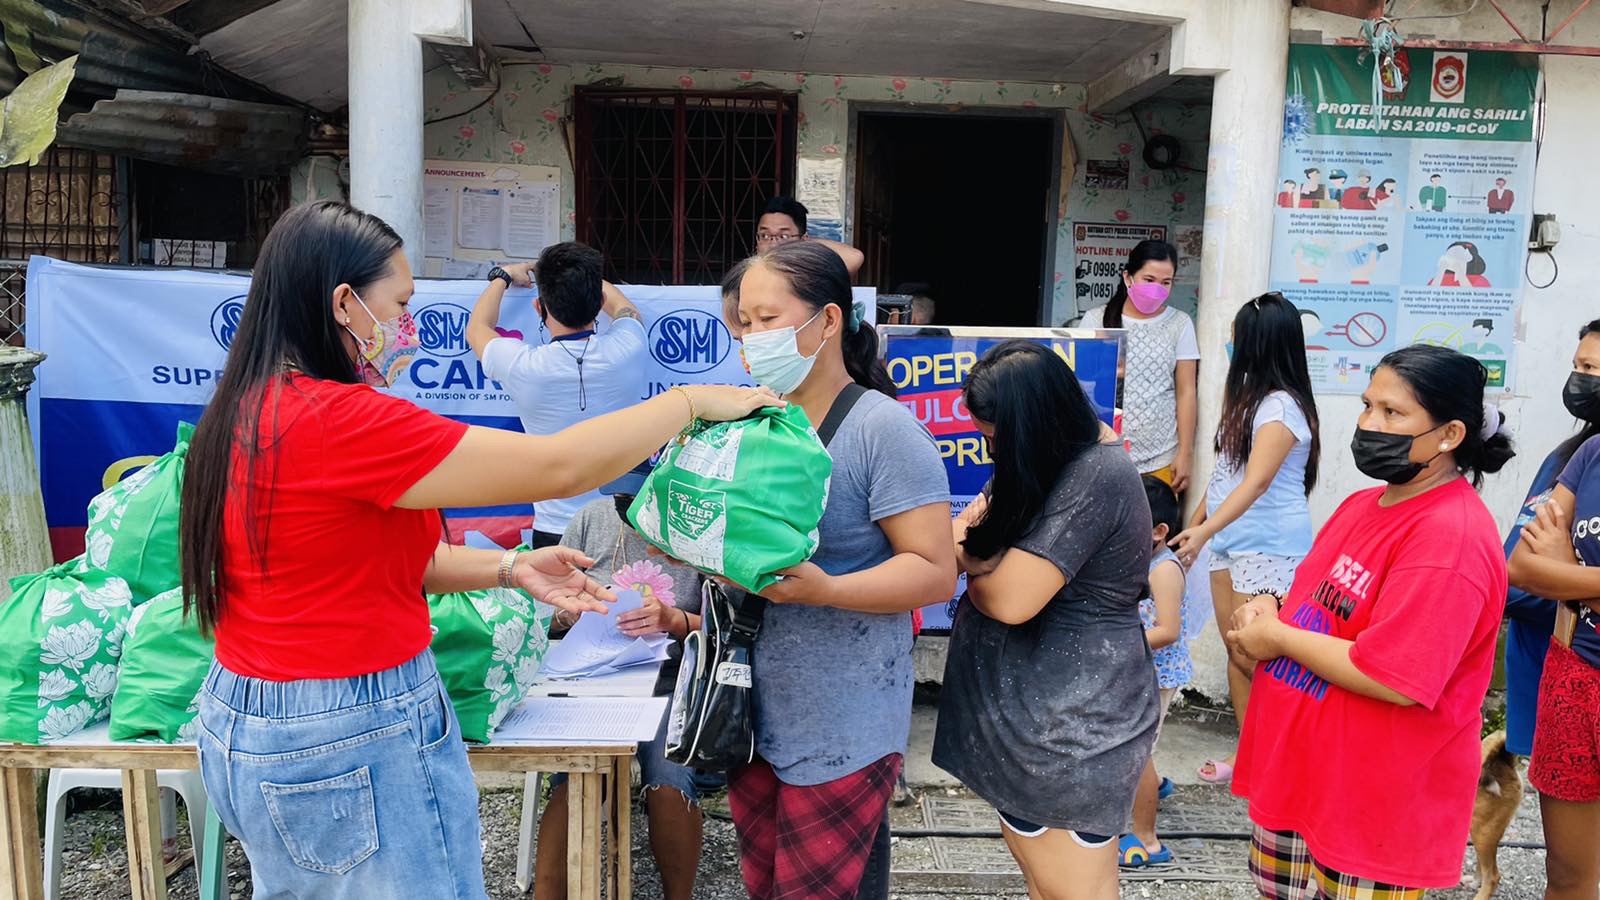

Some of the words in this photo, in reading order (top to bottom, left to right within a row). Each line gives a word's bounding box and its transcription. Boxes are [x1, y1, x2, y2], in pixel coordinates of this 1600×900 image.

[1436, 107, 1470, 119] ANG
[1473, 108, 1527, 120] SARILI
[1335, 118, 1389, 130] LABAN
[1392, 120, 1413, 131] SA
[1415, 121, 1500, 134] 2019-nCoV
[1076, 246, 1113, 255] HOTLINE
[1091, 282, 1114, 300] (085)
[419, 310, 471, 350] SM
[655, 316, 718, 364] SM
[679, 500, 714, 519] TIGER
